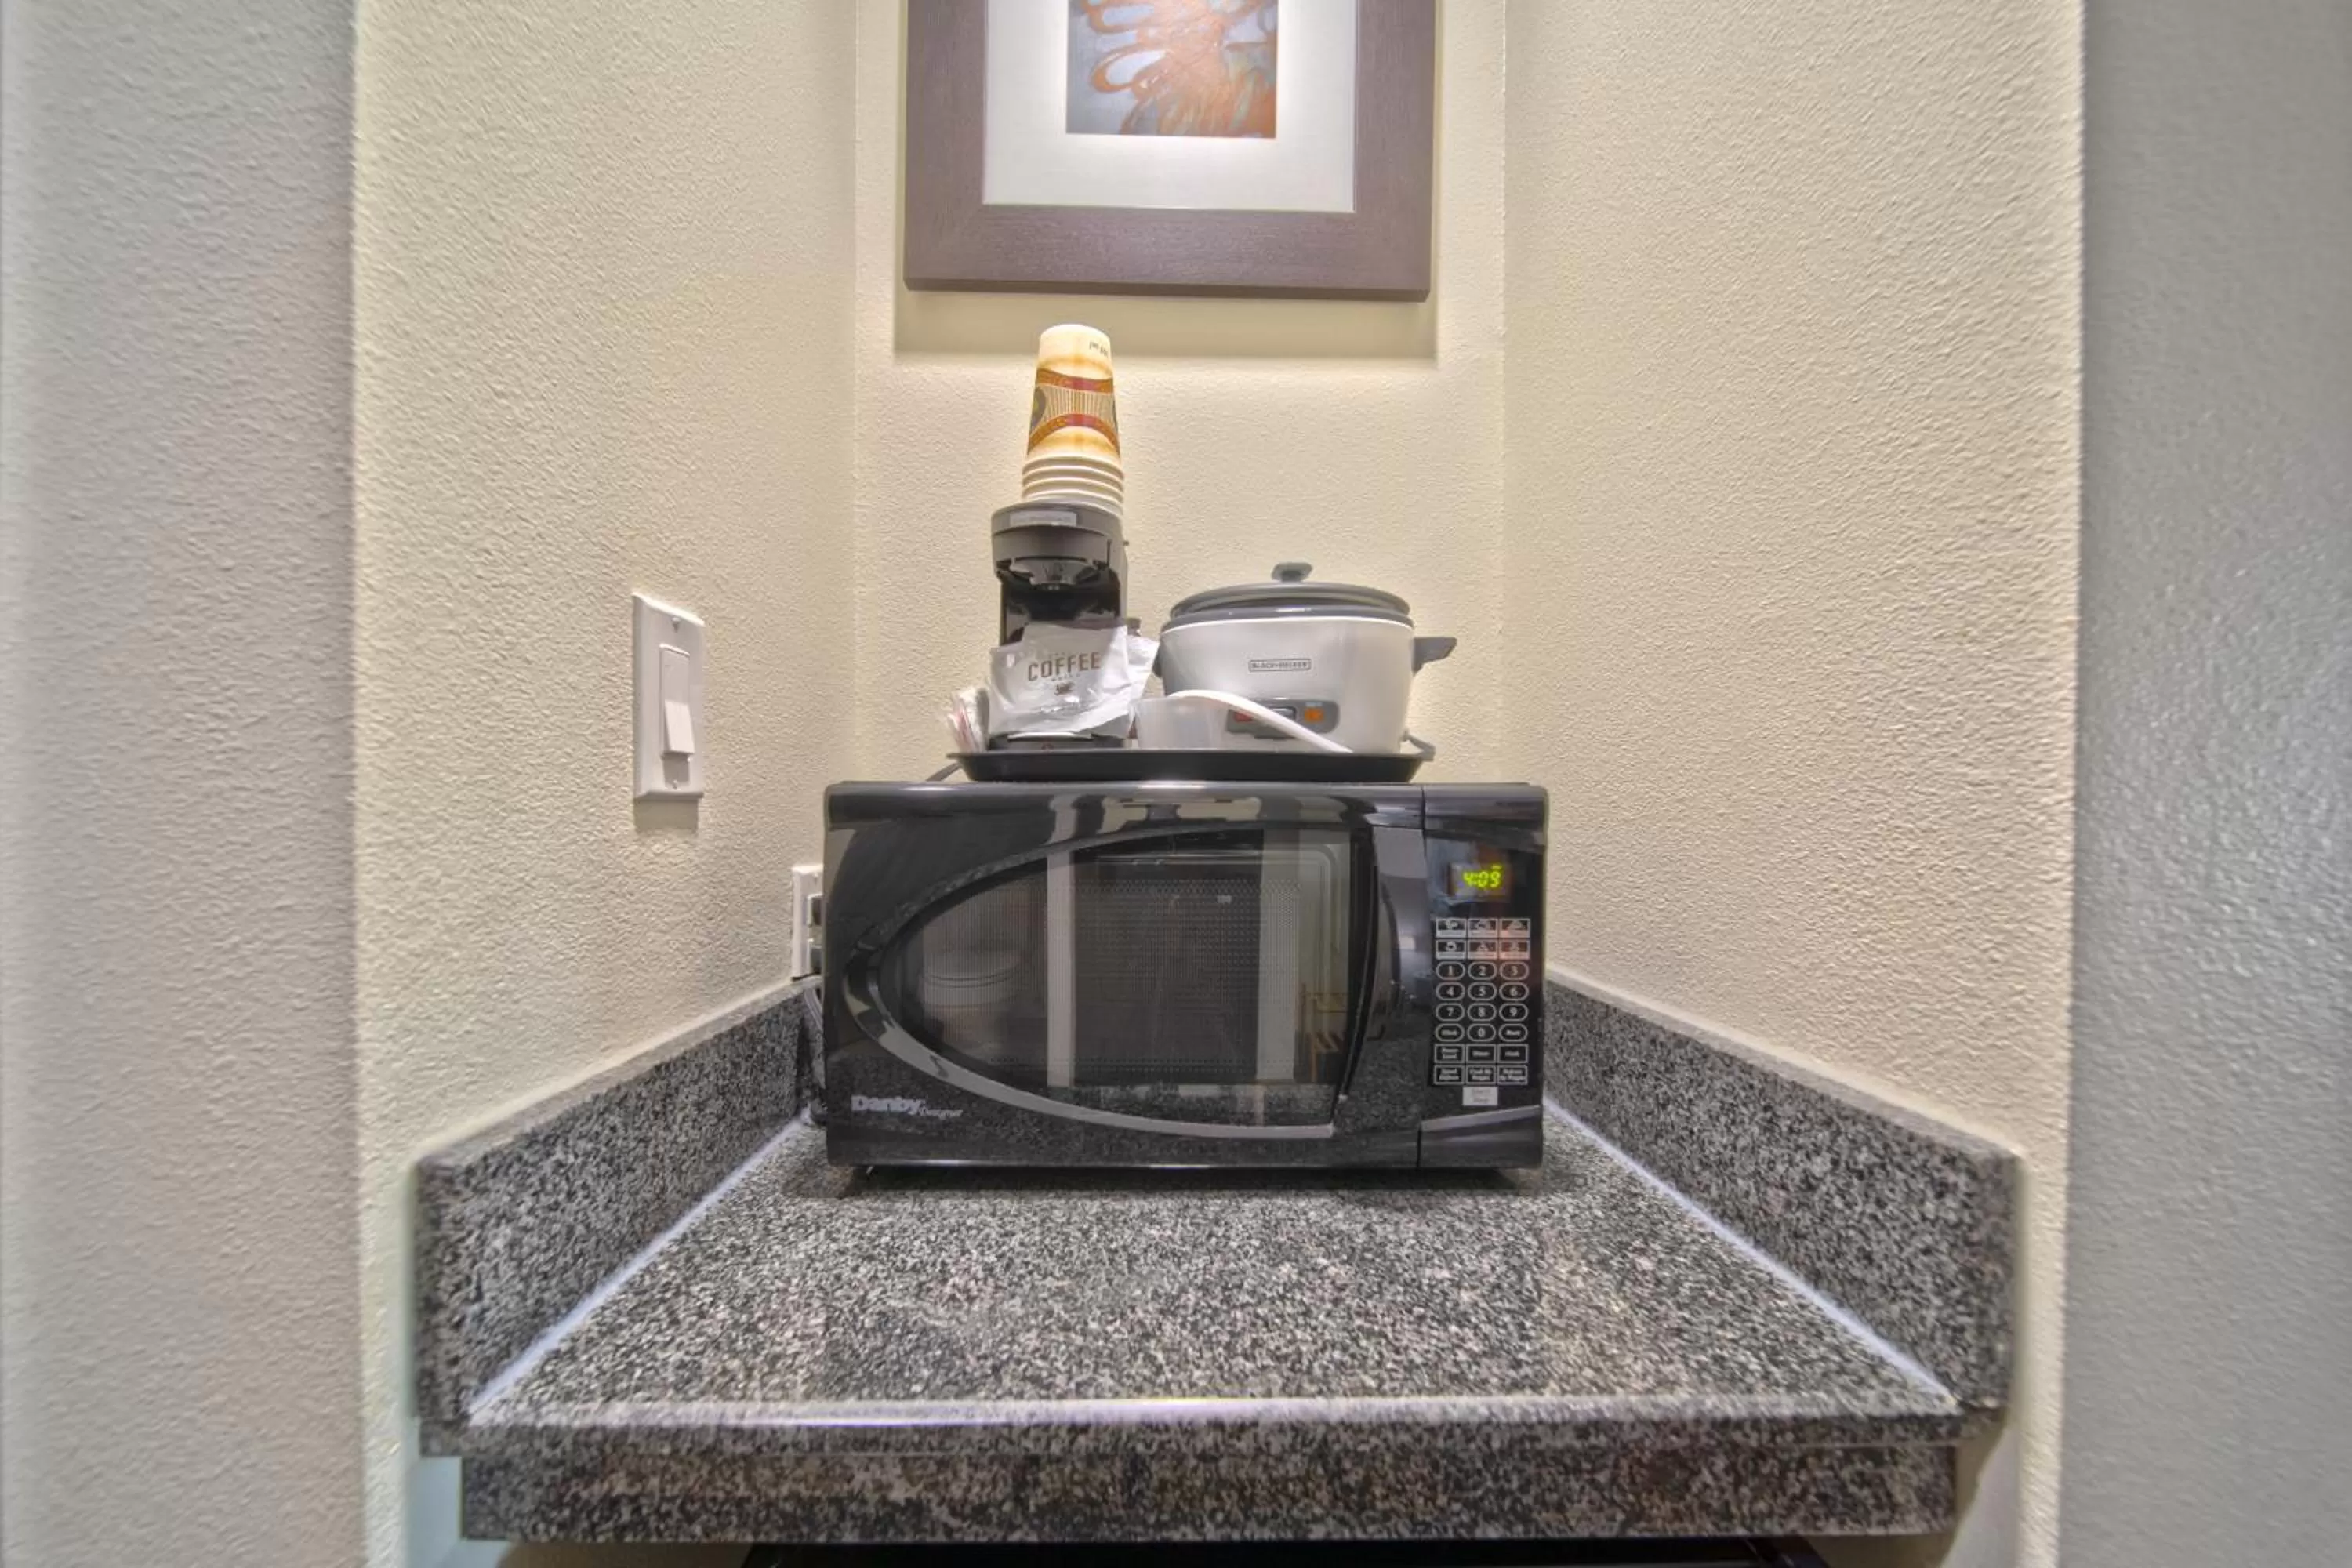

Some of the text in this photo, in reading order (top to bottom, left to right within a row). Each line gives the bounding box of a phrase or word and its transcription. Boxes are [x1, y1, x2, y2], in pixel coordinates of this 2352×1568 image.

[1028, 652, 1102, 681] COFFEE
[1463, 870, 1501, 888] 4:09
[1448, 965, 1454, 976] 1
[1479, 965, 1486, 976] 2
[1511, 965, 1519, 976] 3
[1446, 986, 1454, 996] 4
[1479, 986, 1486, 996] 5
[1510, 986, 1518, 996] 6
[1446, 1007, 1454, 1017] 7
[1478, 1007, 1486, 1017] 8
[1509, 1007, 1518, 1017] 9
[1477, 1027, 1486, 1037] 0
[851, 1095, 924, 1115] Danby
